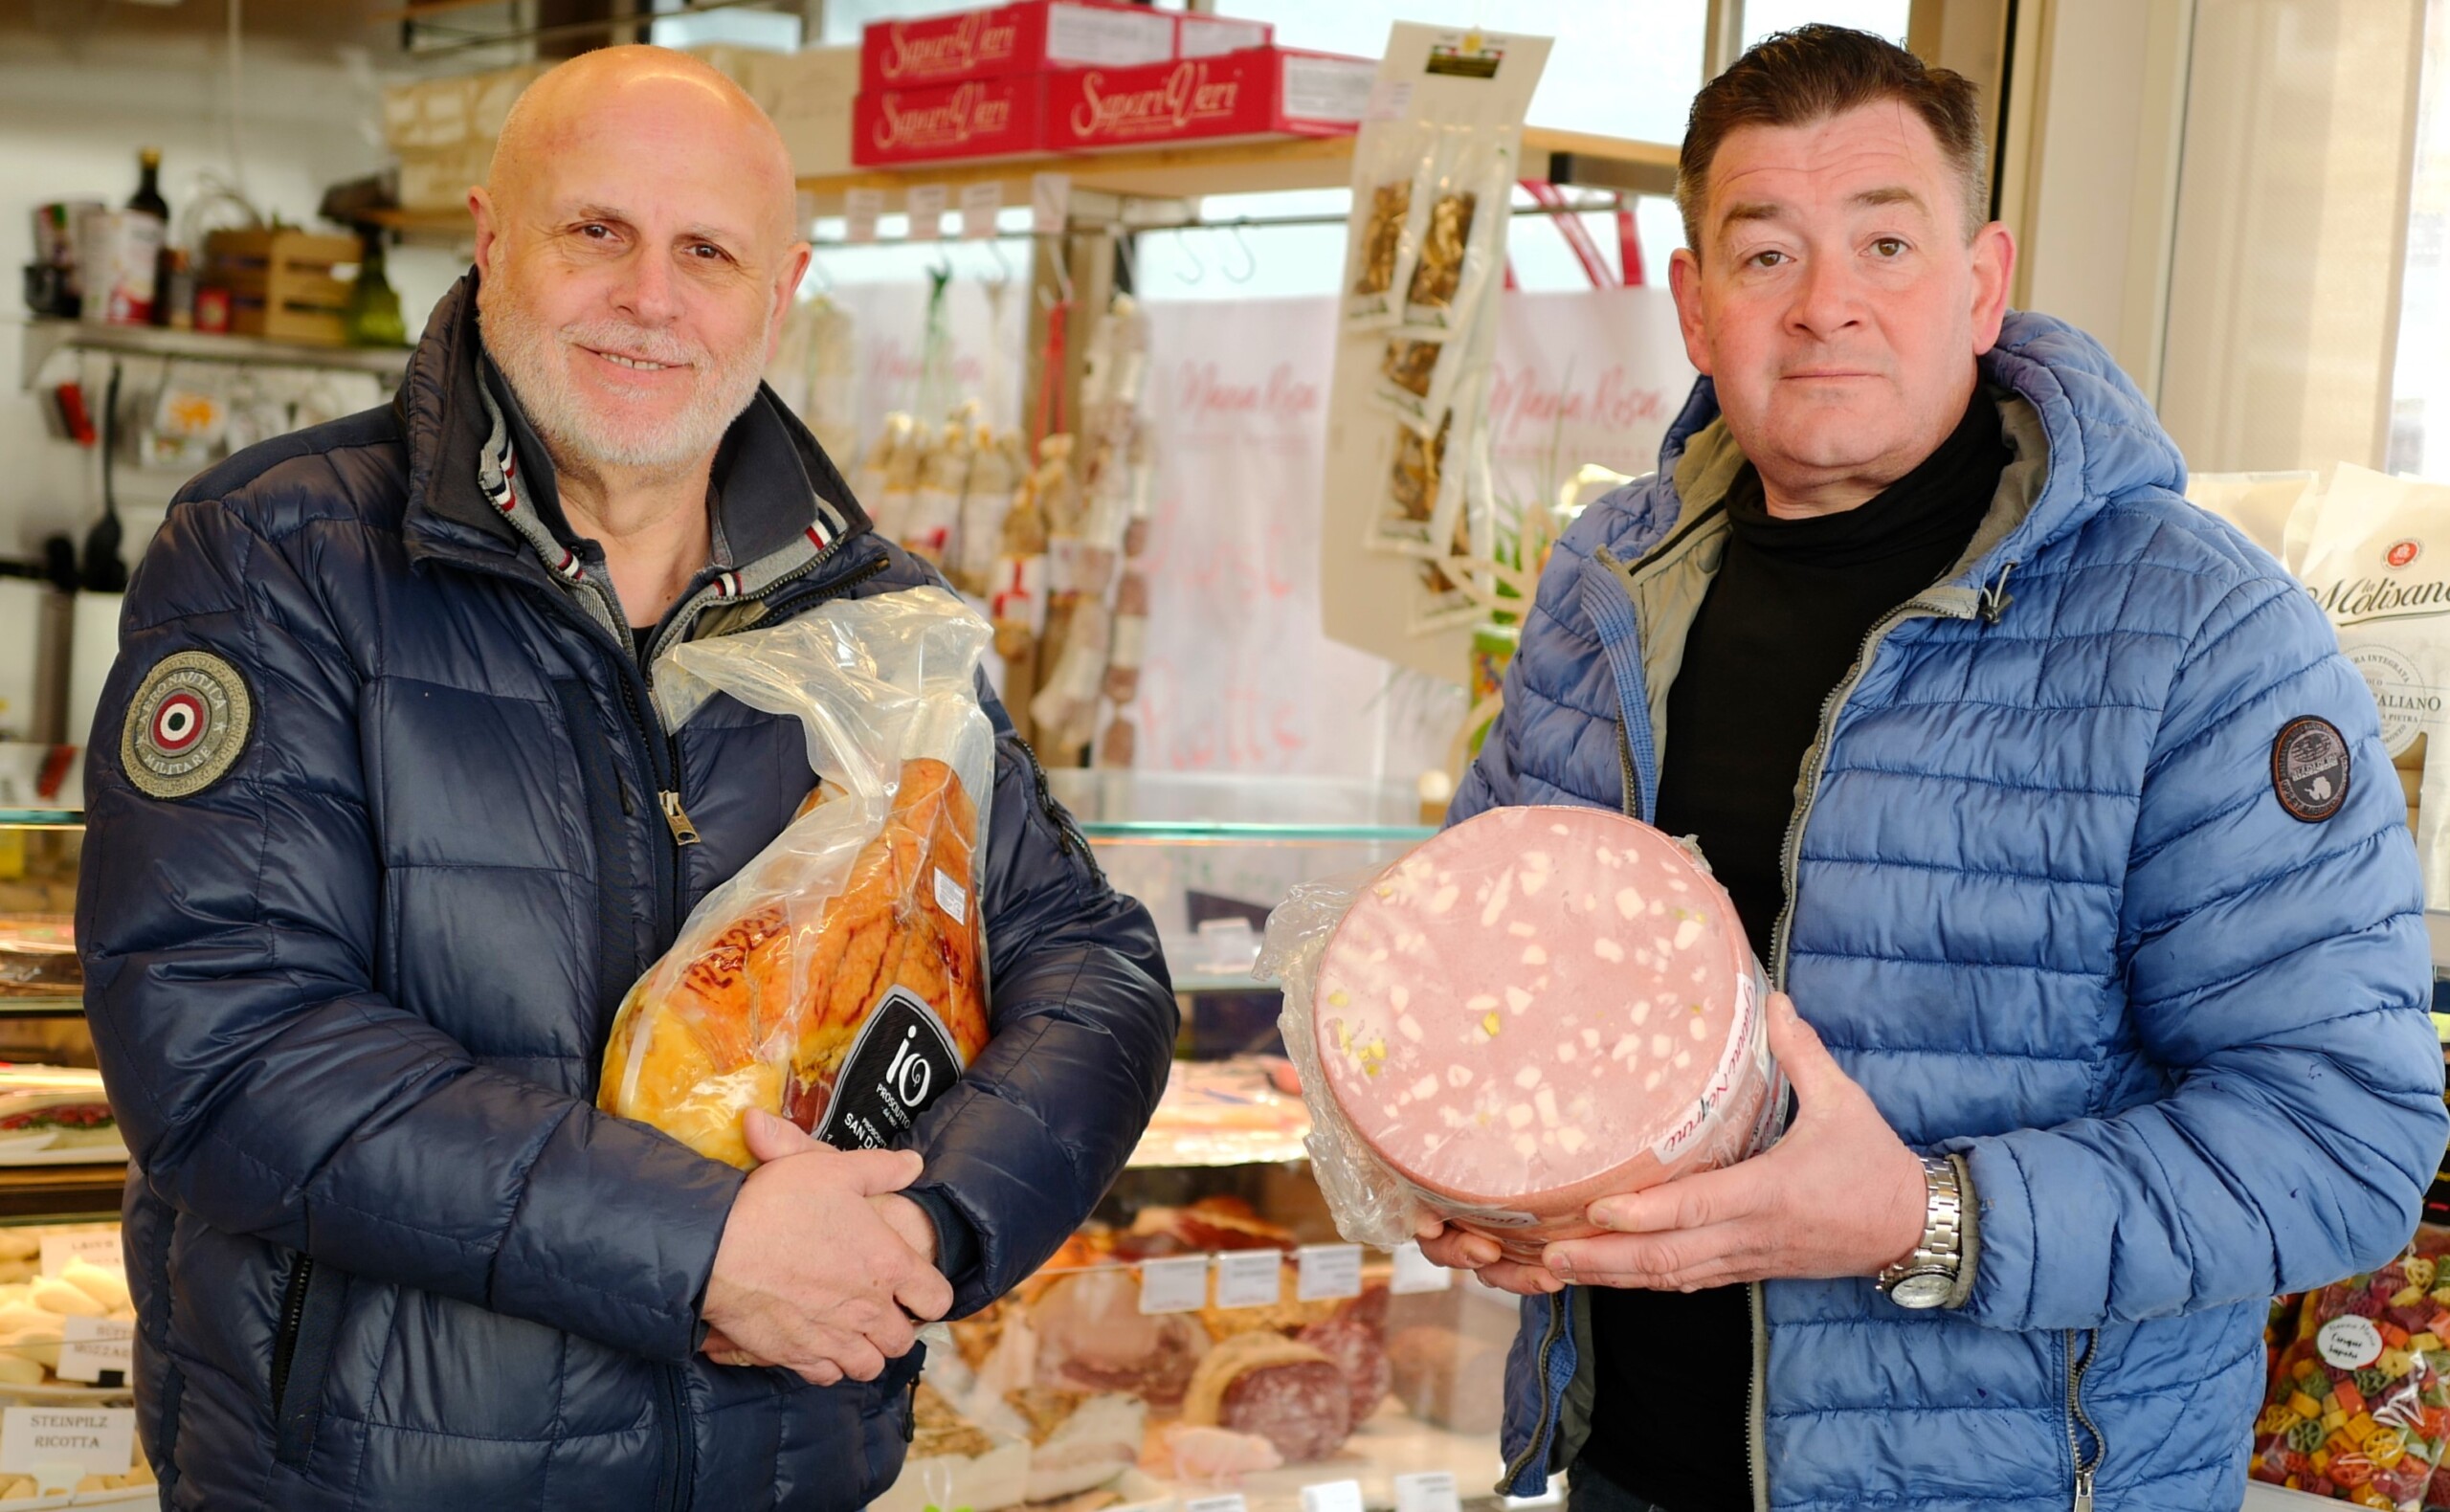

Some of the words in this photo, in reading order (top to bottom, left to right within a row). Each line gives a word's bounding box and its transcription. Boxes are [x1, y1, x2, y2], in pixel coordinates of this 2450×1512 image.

[2368, 654, 2411, 683] INTEGRATA
[140, 671, 227, 724] AERONAUTICA
[145, 745, 212, 776] MILITARE
[876, 1082, 911, 1129] PROSCIUTTO
[843, 1112, 866, 1142] SAN
[861, 1117, 887, 1149] PROSCIUTT
[30, 1415, 108, 1429] STEINPILZ
[33, 1435, 100, 1449] RICOTTA
